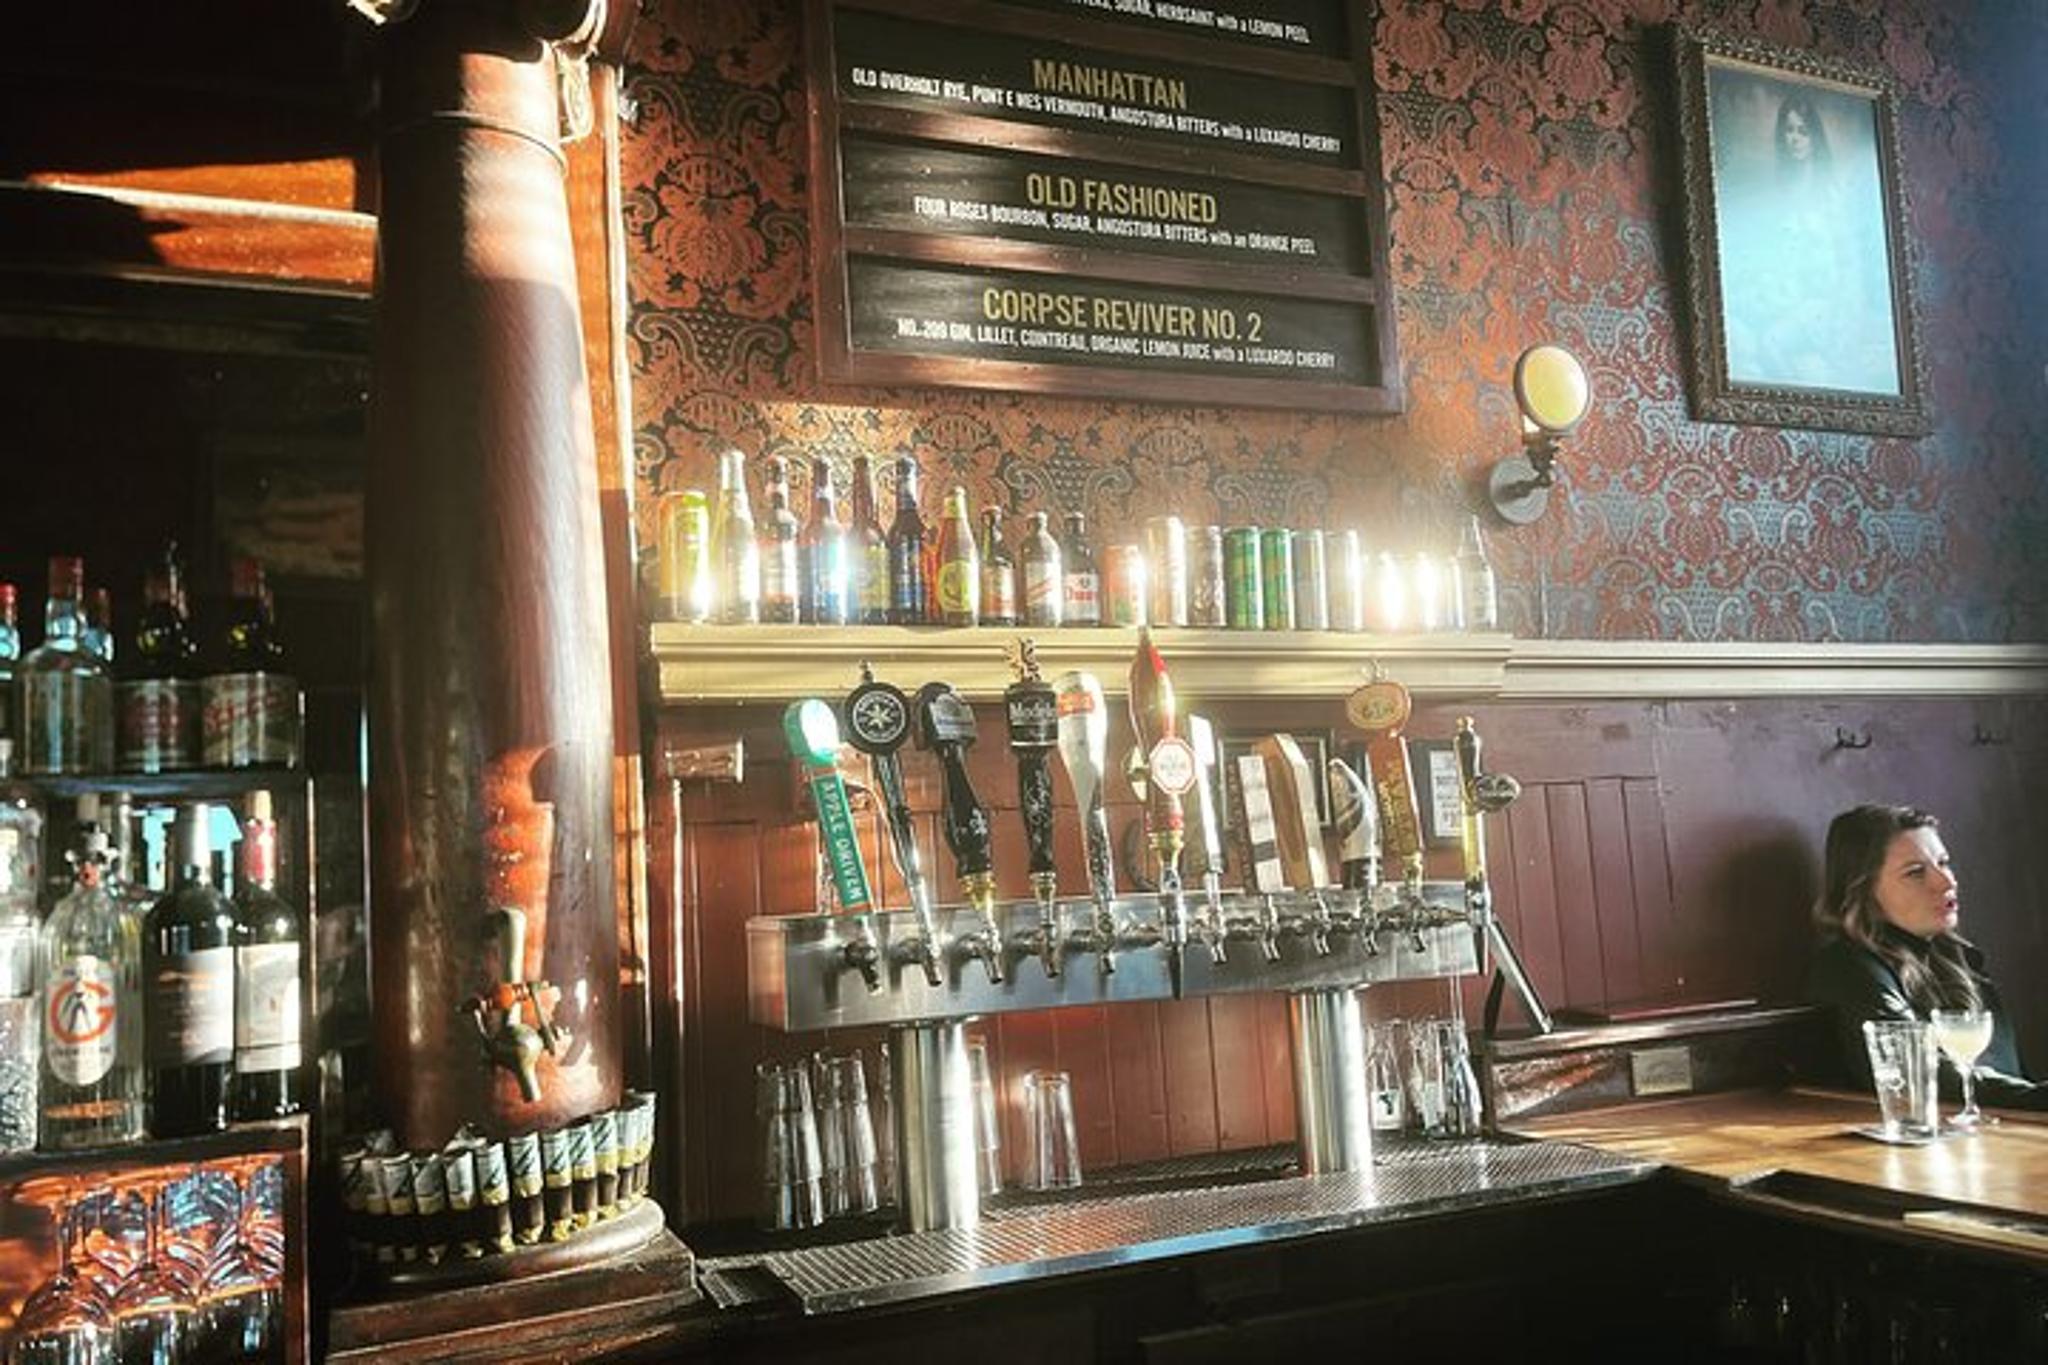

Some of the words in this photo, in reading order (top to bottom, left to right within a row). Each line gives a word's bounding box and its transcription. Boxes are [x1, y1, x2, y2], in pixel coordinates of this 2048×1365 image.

[1217, 13, 1238, 31] with
[1240, 20, 1247, 32] a
[1249, 18, 1283, 38] LEMON
[852, 68, 876, 87] OLD
[879, 72, 940, 96] OVERHOLT
[943, 81, 970, 102] RYE,
[972, 85, 1004, 105] PUNT
[1006, 90, 1013, 106] E
[1043, 96, 1107, 121] VERMOUTH,
[1110, 105, 1175, 129] ANGOSTURA
[1177, 115, 1220, 135] BITTERS
[1222, 123, 1243, 138] with
[1246, 129, 1252, 140] a
[1253, 126, 1300, 146] LUXARDO
[1302, 133, 1340, 152] CHERRY
[1033, 59, 1188, 110] MANHATTAN
[1026, 172, 1077, 209] OLD
[1083, 179, 1218, 224] FASHIONED
[914, 196, 947, 216] FOUR
[949, 200, 988, 220] ROSES
[991, 204, 1050, 228] BOURBON,
[1052, 211, 1094, 233] SUGAR,
[1097, 216, 1163, 238] ANGOSTURA
[1164, 223, 1208, 243] BITTERS
[1209, 229, 1232, 245] with
[1234, 235, 1246, 247] an
[1248, 232, 1289, 251] ORANGE
[1291, 237, 1316, 254] PEEL
[984, 287, 1088, 328] CORPSE
[1093, 298, 1196, 337] REVIVER
[1202, 308, 1242, 340] NO.
[1247, 312, 1262, 343] 2
[978, 324, 1019, 346] LILLET,
[1020, 328, 1090, 351] COINTREAU,
[1092, 334, 1141, 353] ORGANIC
[1143, 338, 1181, 356] LEMON
[1183, 341, 1211, 358] JUICE
[1213, 344, 1236, 360] with
[1238, 349, 1243, 361] a
[1245, 346, 1295, 365] LUXARDO
[1296, 350, 1335, 368] CHERRY
[824, 781, 845, 834] APPLE
